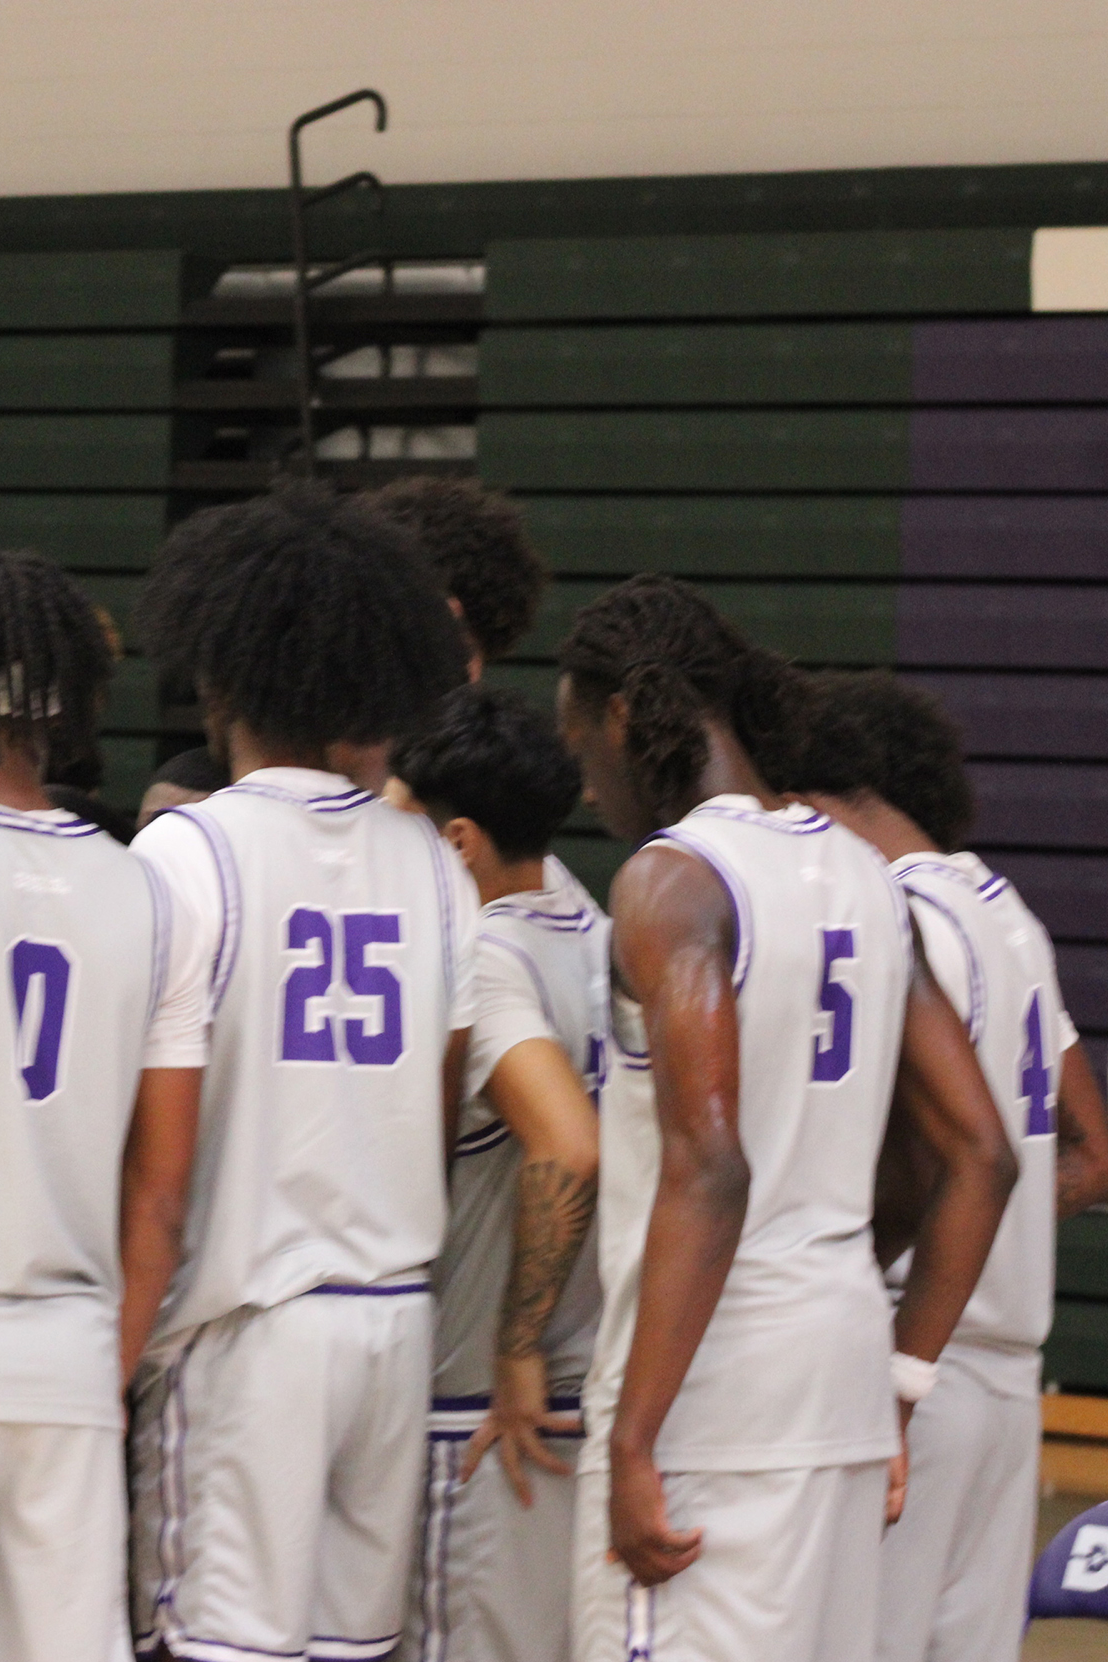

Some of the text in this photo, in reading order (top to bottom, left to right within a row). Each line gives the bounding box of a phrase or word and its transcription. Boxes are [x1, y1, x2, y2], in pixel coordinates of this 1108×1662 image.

[8, 936, 75, 1104] 0
[277, 903, 410, 1068] 25
[810, 925, 857, 1085] 5
[1008, 986, 1055, 1139] 4
